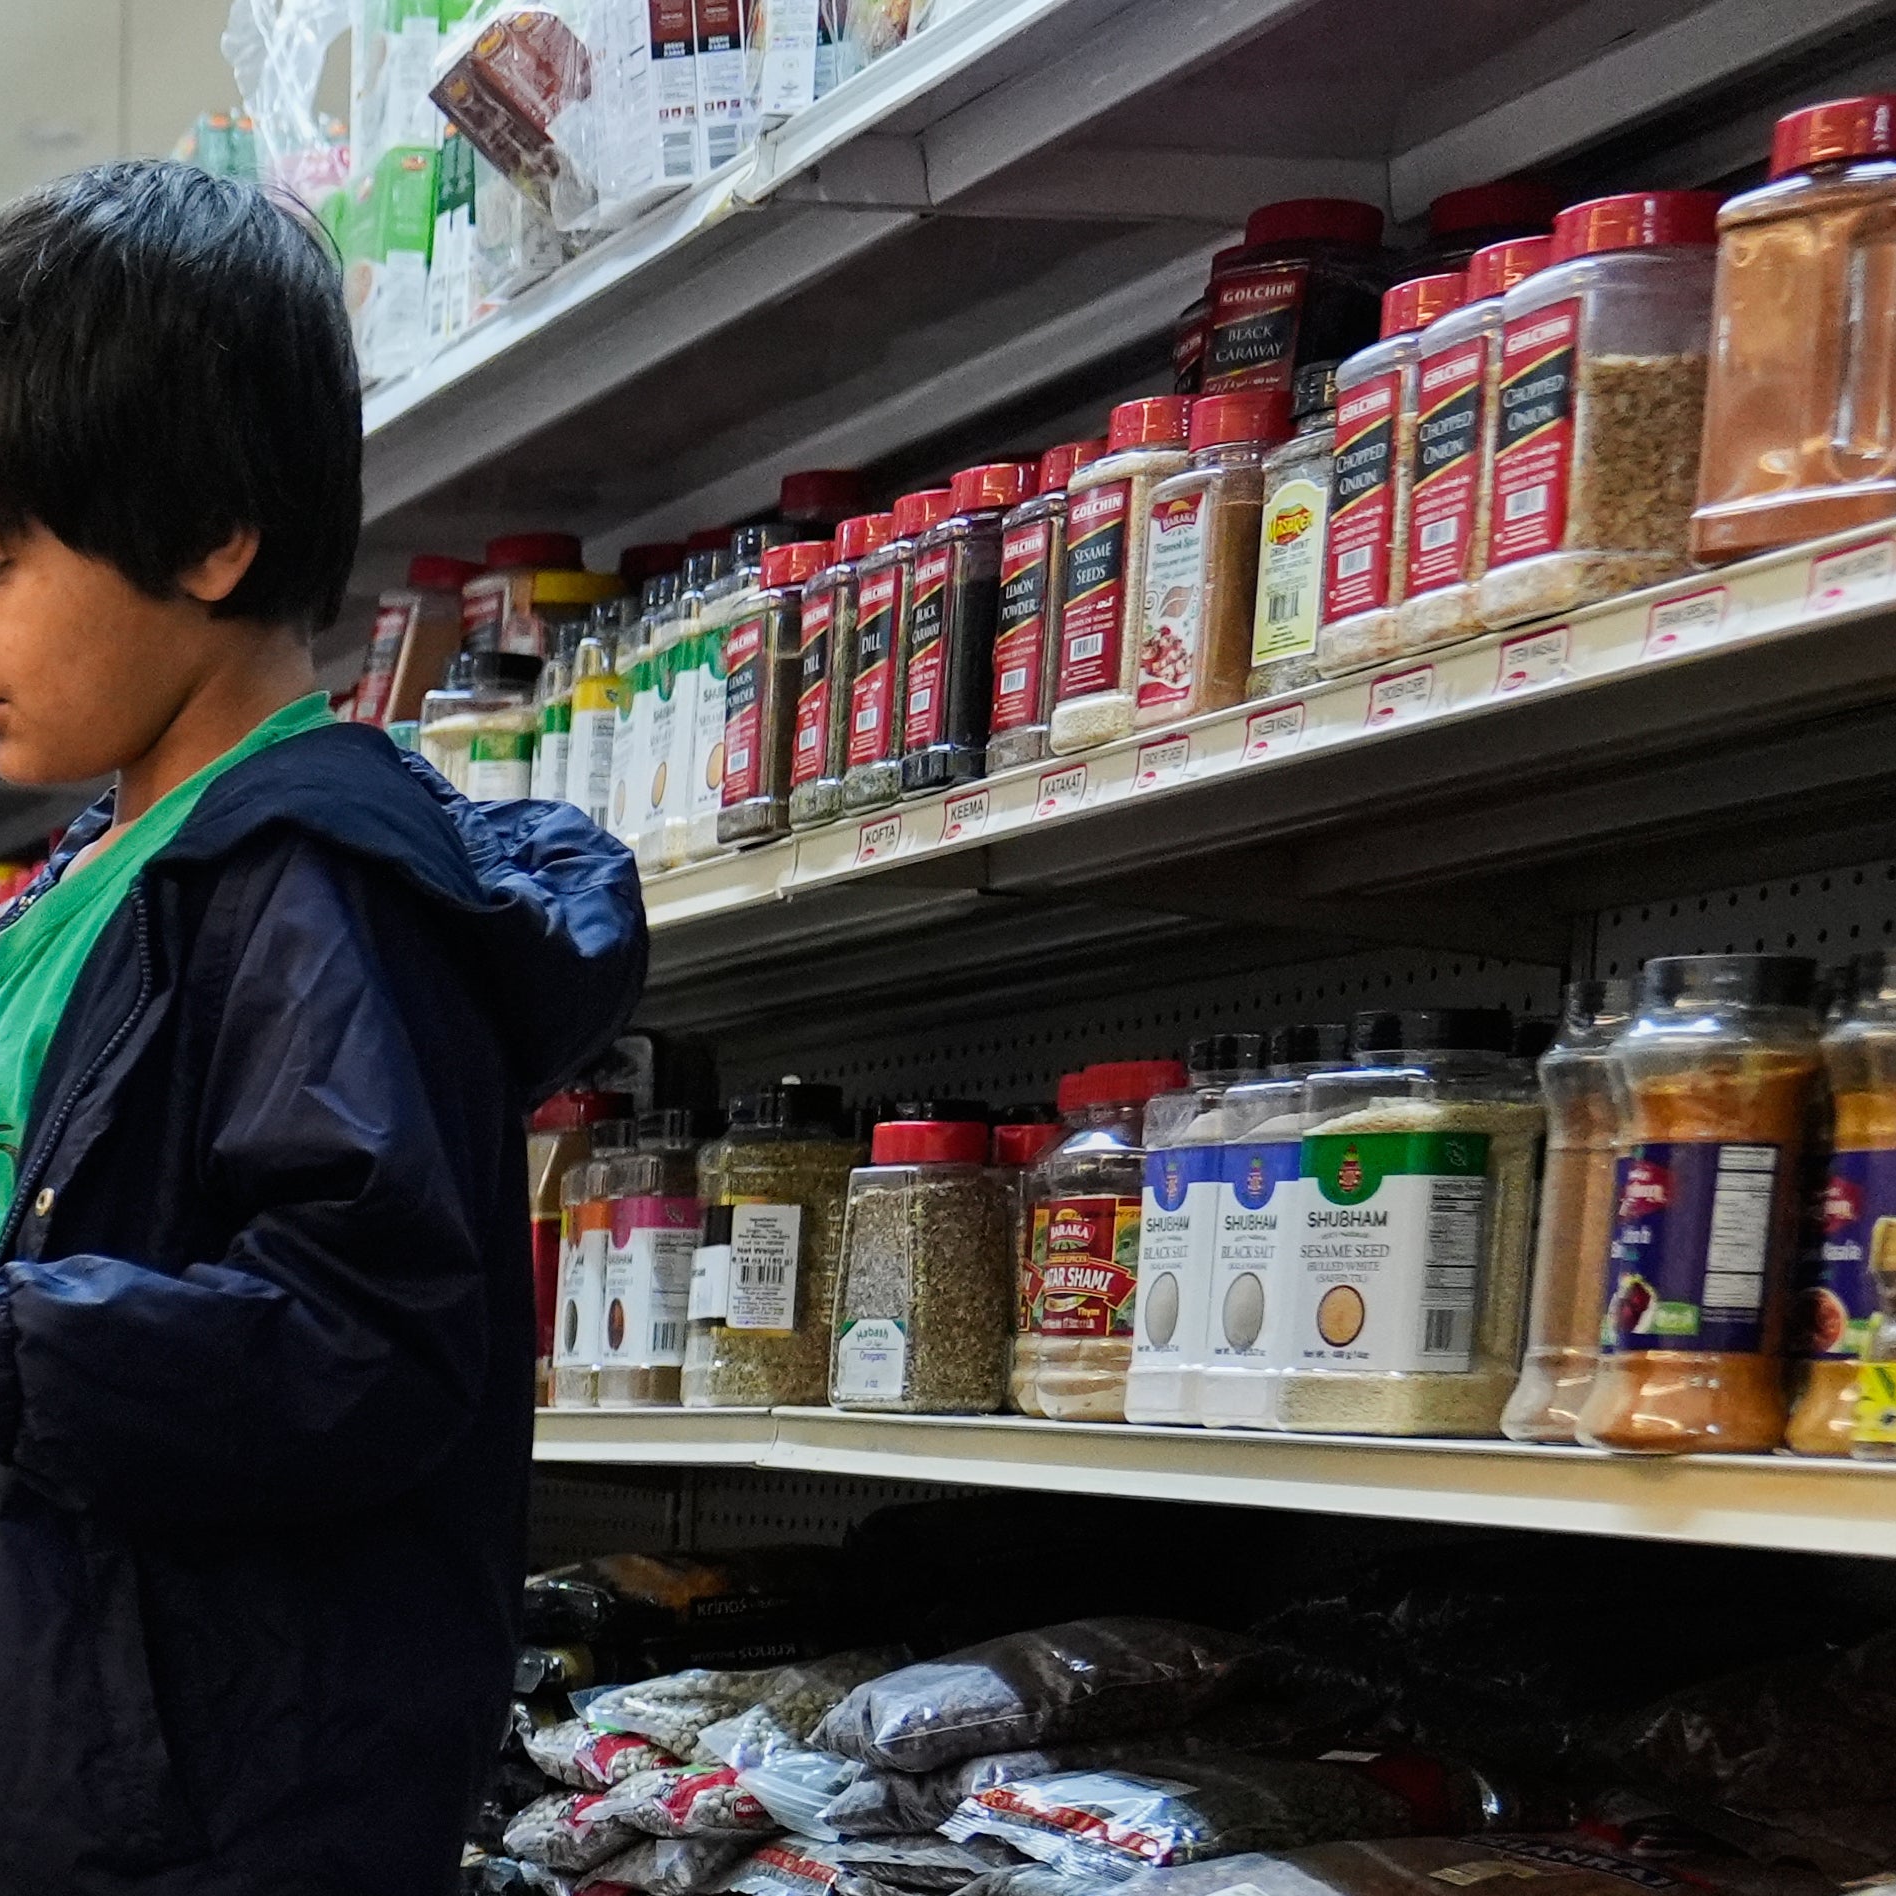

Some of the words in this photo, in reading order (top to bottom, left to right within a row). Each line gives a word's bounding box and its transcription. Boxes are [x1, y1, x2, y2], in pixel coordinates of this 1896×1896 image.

[1222, 281, 1294, 304] GOLCHIN
[1228, 325, 1273, 342] BLACK
[1507, 319, 1571, 352] GOLCHIN
[1215, 343, 1284, 363] CARAWAY
[1422, 355, 1480, 390] GOLCHIN
[1502, 374, 1565, 408] CHOPPED
[1338, 390, 1391, 422] GOLCHIN
[1507, 401, 1555, 431] ONION
[1419, 411, 1475, 442] CHOPPED
[1336, 442, 1388, 474] CHOPPED
[1423, 437, 1465, 465] ONION
[1339, 468, 1378, 495] ONION
[1071, 494, 1123, 520] GOLCHIN
[1162, 511, 1196, 532] BARAKA
[1004, 534, 1044, 560] GOLCHIN
[1073, 541, 1112, 566] SESAME
[915, 558, 946, 583] GOLCHIN
[1075, 564, 1107, 586] SEEDS
[1005, 577, 1036, 600] LEMON
[916, 603, 937, 623] BLACK
[1001, 599, 1037, 622] POWDER
[861, 631, 882, 655] DILL
[911, 622, 941, 645] CARAWAY
[1146, 1215, 1191, 1233] SHUBHAM
[1224, 1214, 1278, 1231] SHUBHAM
[1306, 1210, 1388, 1229] SHUBHAM
[1049, 1223, 1090, 1240] BARAKA
[1143, 1245, 1172, 1260] BLACK
[1221, 1245, 1252, 1260] BLACK
[1299, 1244, 1353, 1259] SESAME
[1355, 1243, 1391, 1258] SEED
[1346, 1261, 1381, 1272] WHITE
